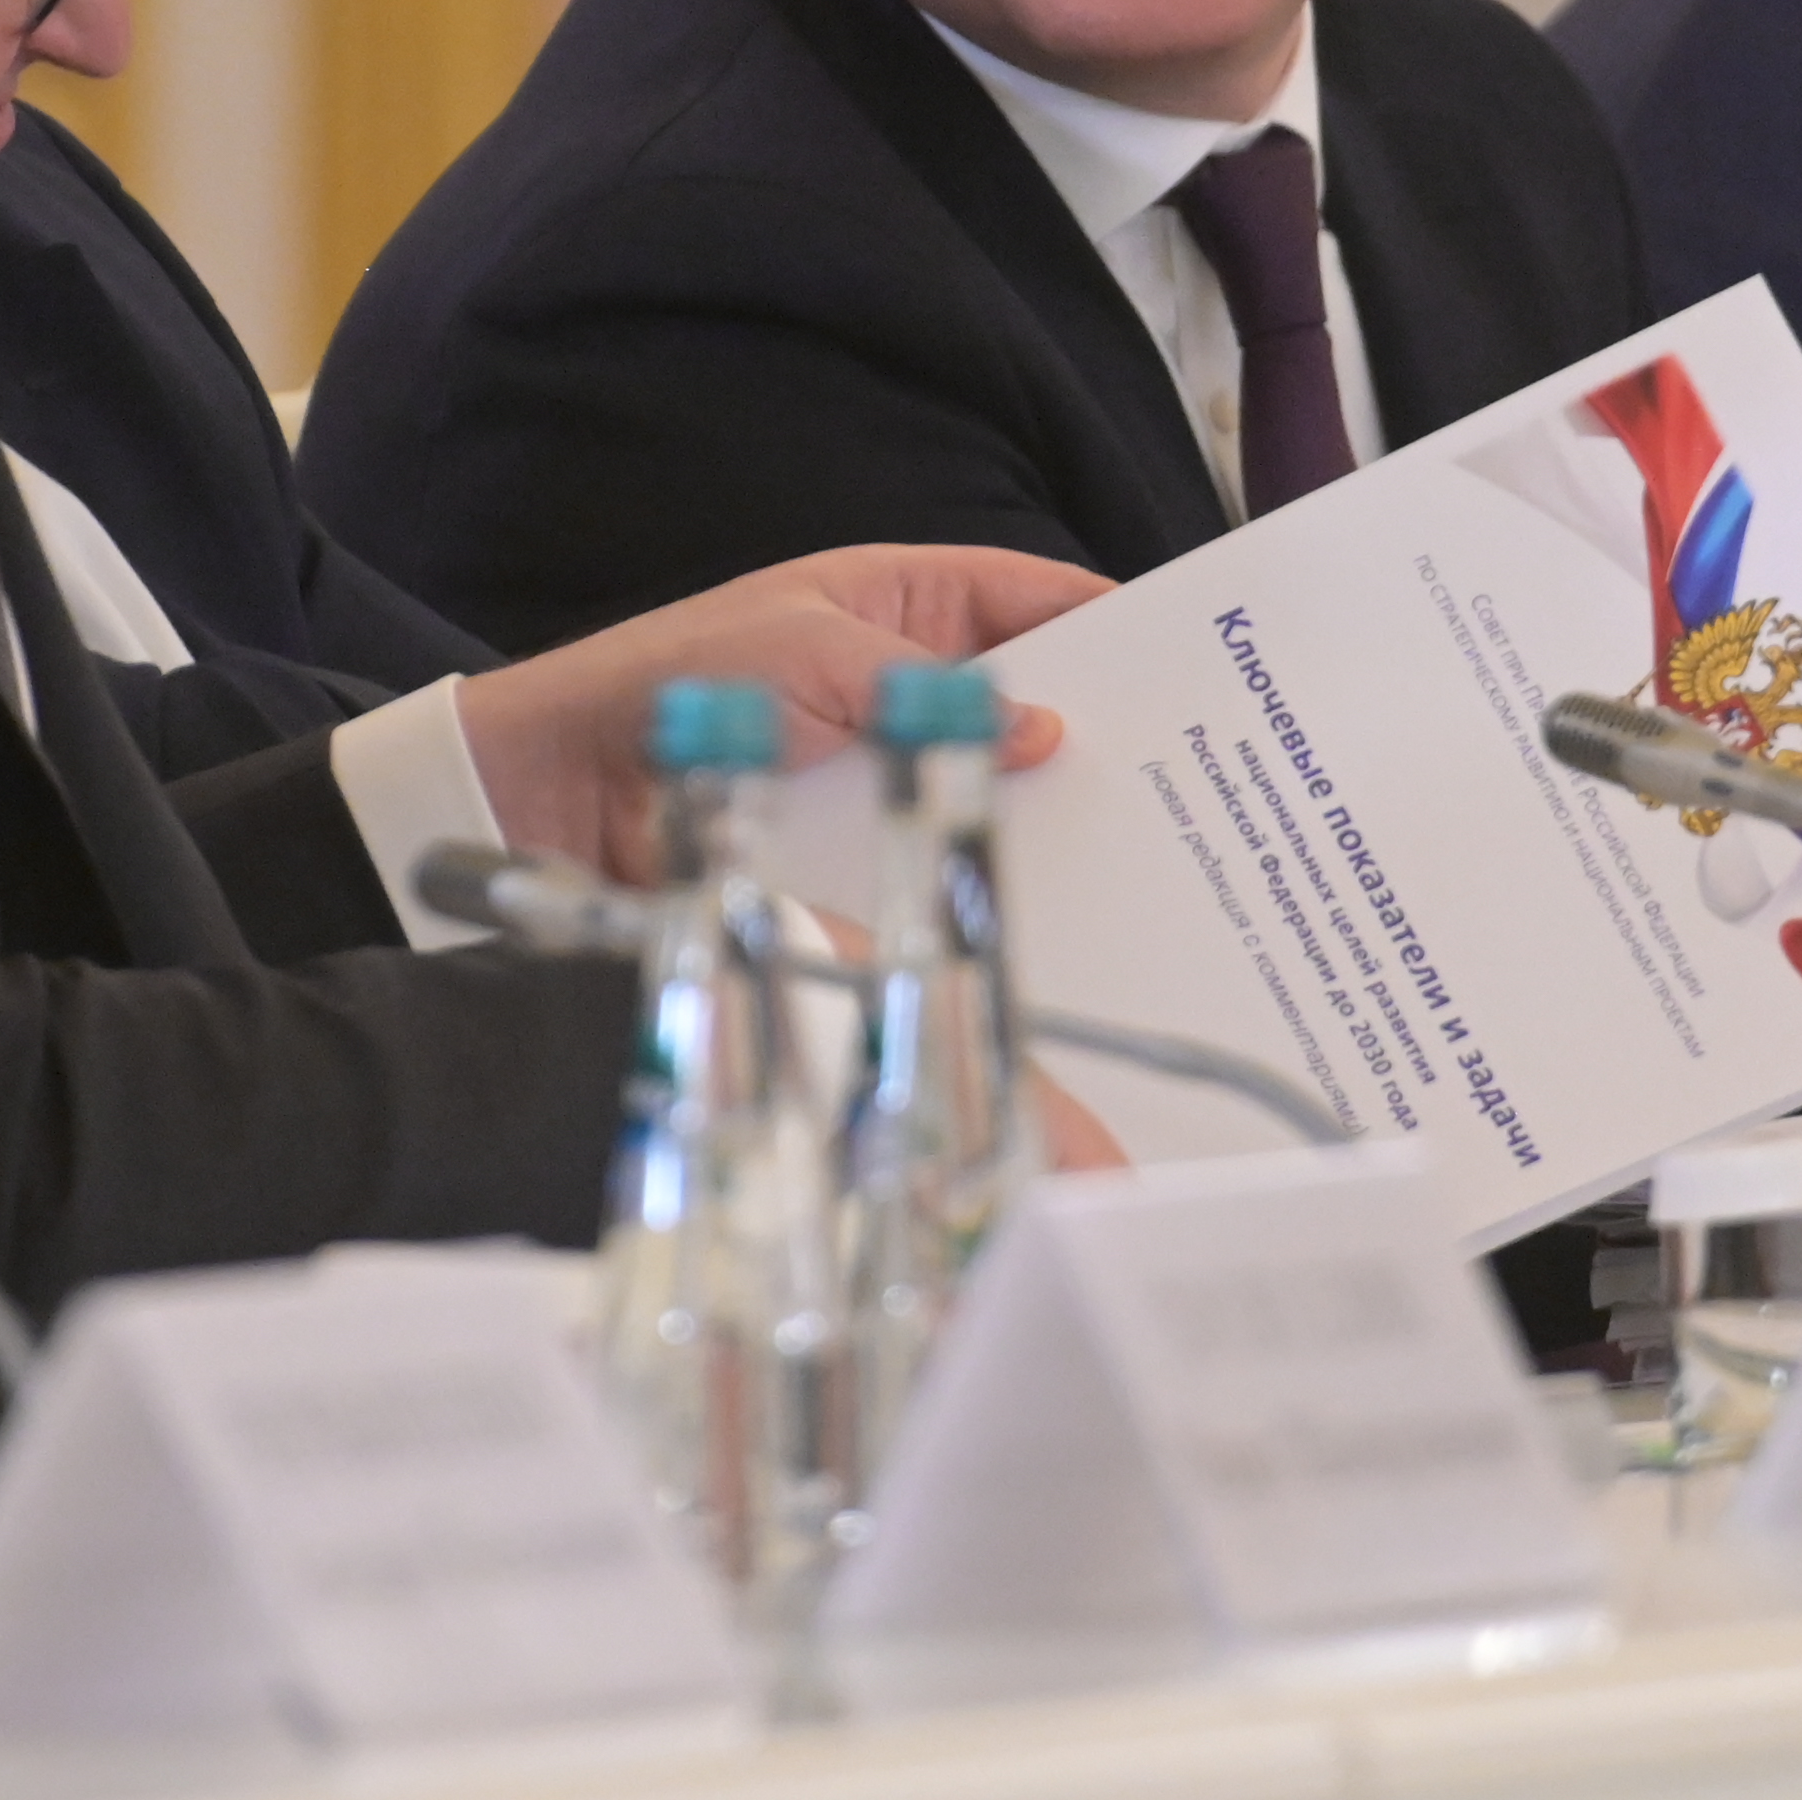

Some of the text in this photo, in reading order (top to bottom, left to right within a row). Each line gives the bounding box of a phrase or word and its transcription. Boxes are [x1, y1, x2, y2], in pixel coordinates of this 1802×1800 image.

[1138, 760, 1194, 828] (новая
[1177, 830, 1252, 930] редакция
[1241, 932, 1262, 948] с
[1182, 722, 1419, 1131] Российской Федерации до 2030 года
[1212, 605, 1542, 1168] Ключевые показатели и задачи
[1234, 738, 1437, 1085] национальных целей развития
